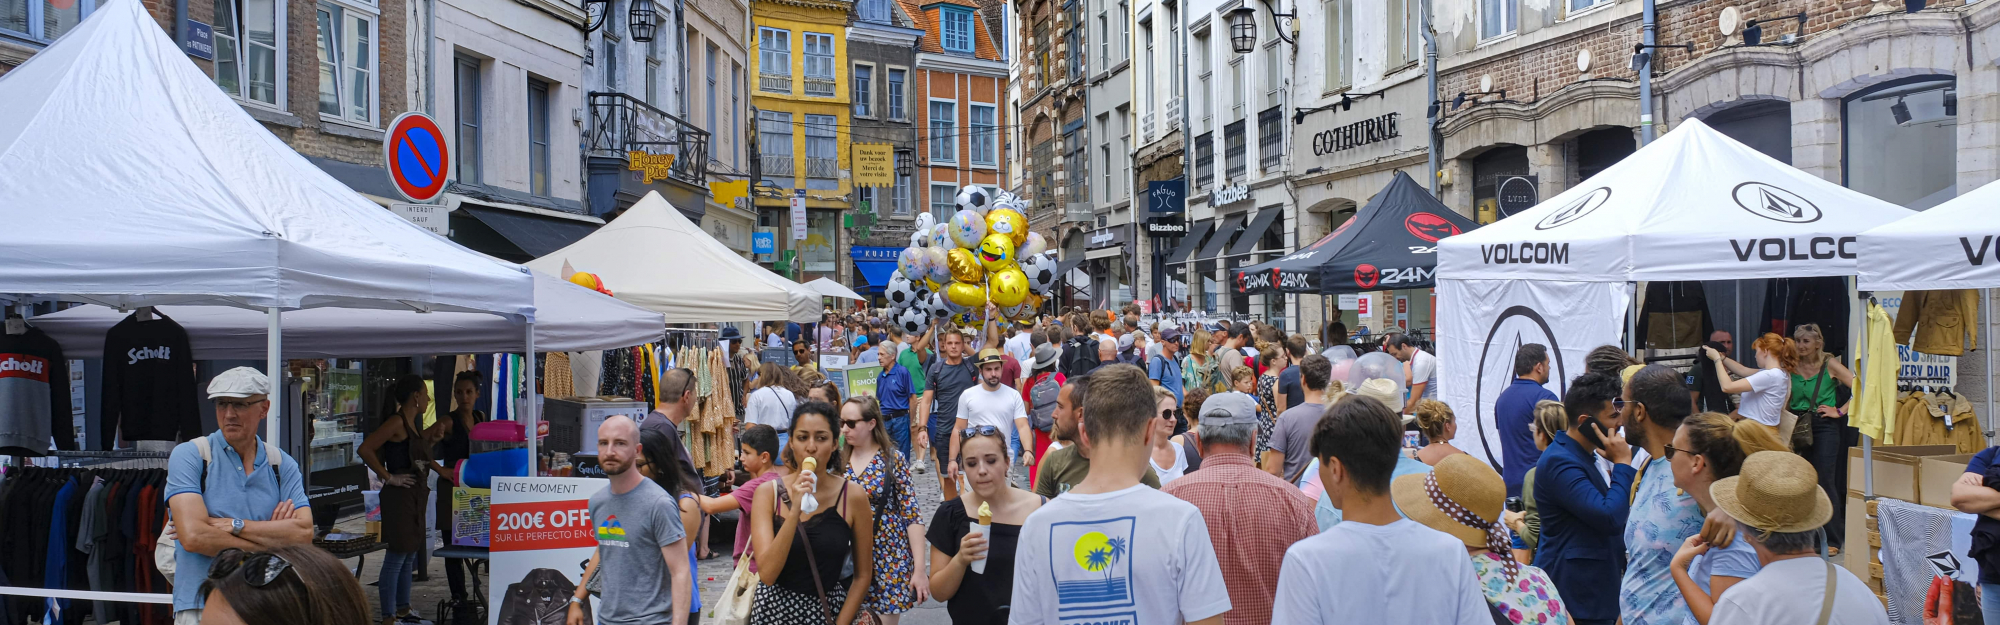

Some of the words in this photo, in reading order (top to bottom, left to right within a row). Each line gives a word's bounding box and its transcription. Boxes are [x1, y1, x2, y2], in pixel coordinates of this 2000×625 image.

[197, 28, 208, 39] Place
[192, 41, 212, 55] PATINIERS
[1312, 111, 1399, 156] COTHURNE
[630, 152, 674, 169] Honey
[644, 166, 668, 184] Pie
[1152, 184, 1176, 198] FAGUO
[1214, 184, 1248, 207] Bizzbee
[1149, 223, 1184, 232] Bizzbee
[865, 250, 902, 258] KUJTE
[1481, 242, 1569, 264] VOLCOM
[1730, 236, 1856, 262] VOLCO
[1959, 235, 2000, 266] V
[1280, 272, 1310, 288] 24MX
[1380, 267, 1437, 284] 24M
[128, 345, 171, 365] Schott
[856, 377, 878, 386] SMOO
[1899, 364, 1923, 383] VERY
[1927, 365, 1951, 384] PAIR
[497, 482, 511, 492] EN
[513, 482, 527, 492] CE
[529, 483, 578, 493] MOMENT
[497, 511, 545, 530] 200€
[494, 533, 513, 542] SUR
[514, 532, 524, 541] LE
[526, 530, 572, 540] PERFECTO
[574, 529, 587, 538] EN
